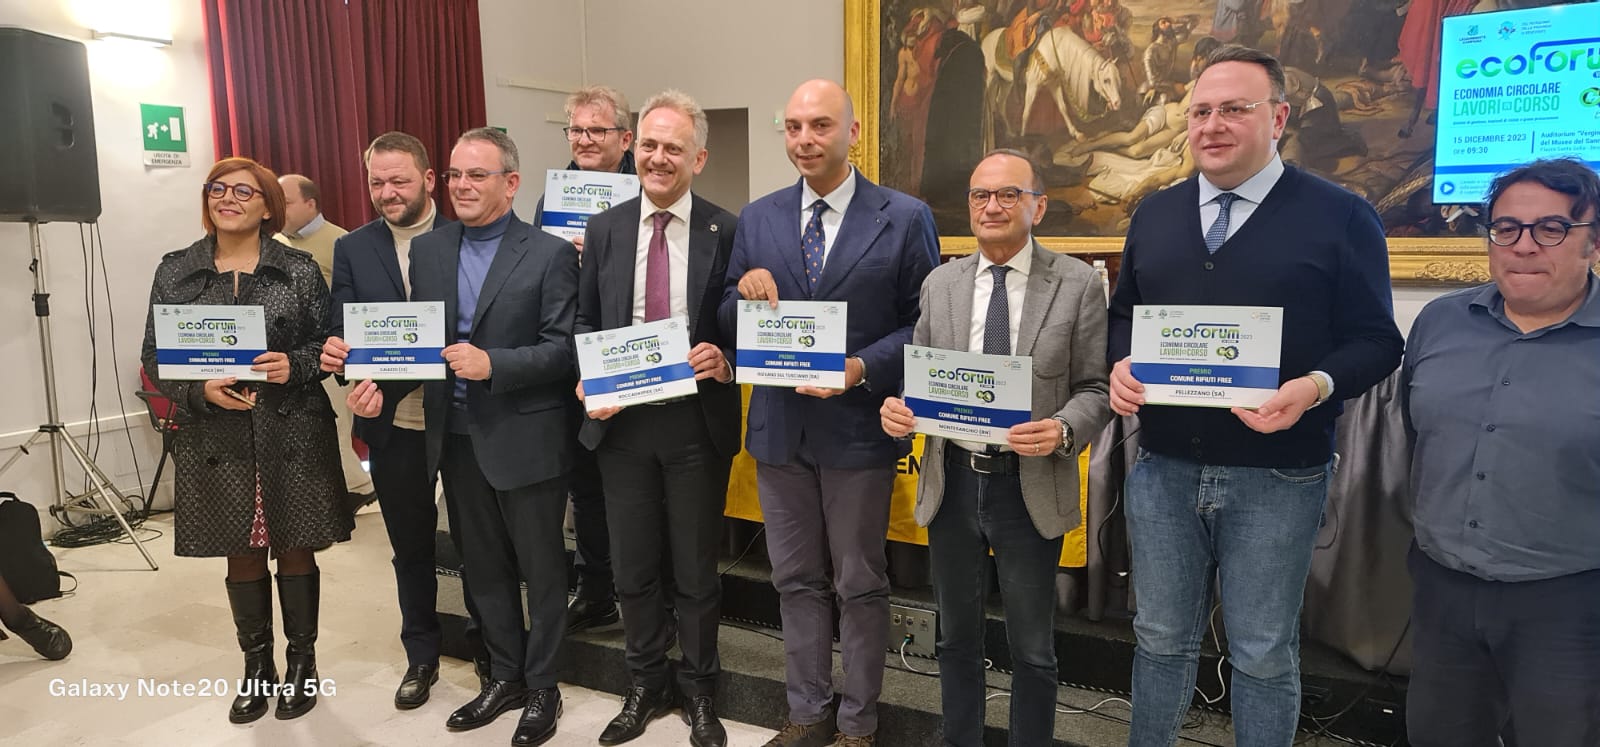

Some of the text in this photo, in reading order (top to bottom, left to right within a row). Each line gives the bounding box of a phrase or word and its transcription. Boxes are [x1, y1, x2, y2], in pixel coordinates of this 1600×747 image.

[1454, 82, 1561, 100] ECONOMIA CIRCOLARE
[1453, 99, 1500, 116] LAVORI
[1514, 95, 1560, 112] CORSO
[1464, 134, 1505, 144] DICEMBRE
[1507, 134, 1527, 142] 2023
[563, 184, 612, 196] ecoforum
[177, 318, 236, 330] ecoforum
[364, 316, 418, 328] ecoforum
[758, 316, 815, 330] ecoforum
[1161, 323, 1240, 339] ecoforum
[601, 335, 660, 356] ecoforum
[929, 368, 995, 385] ecoforum
